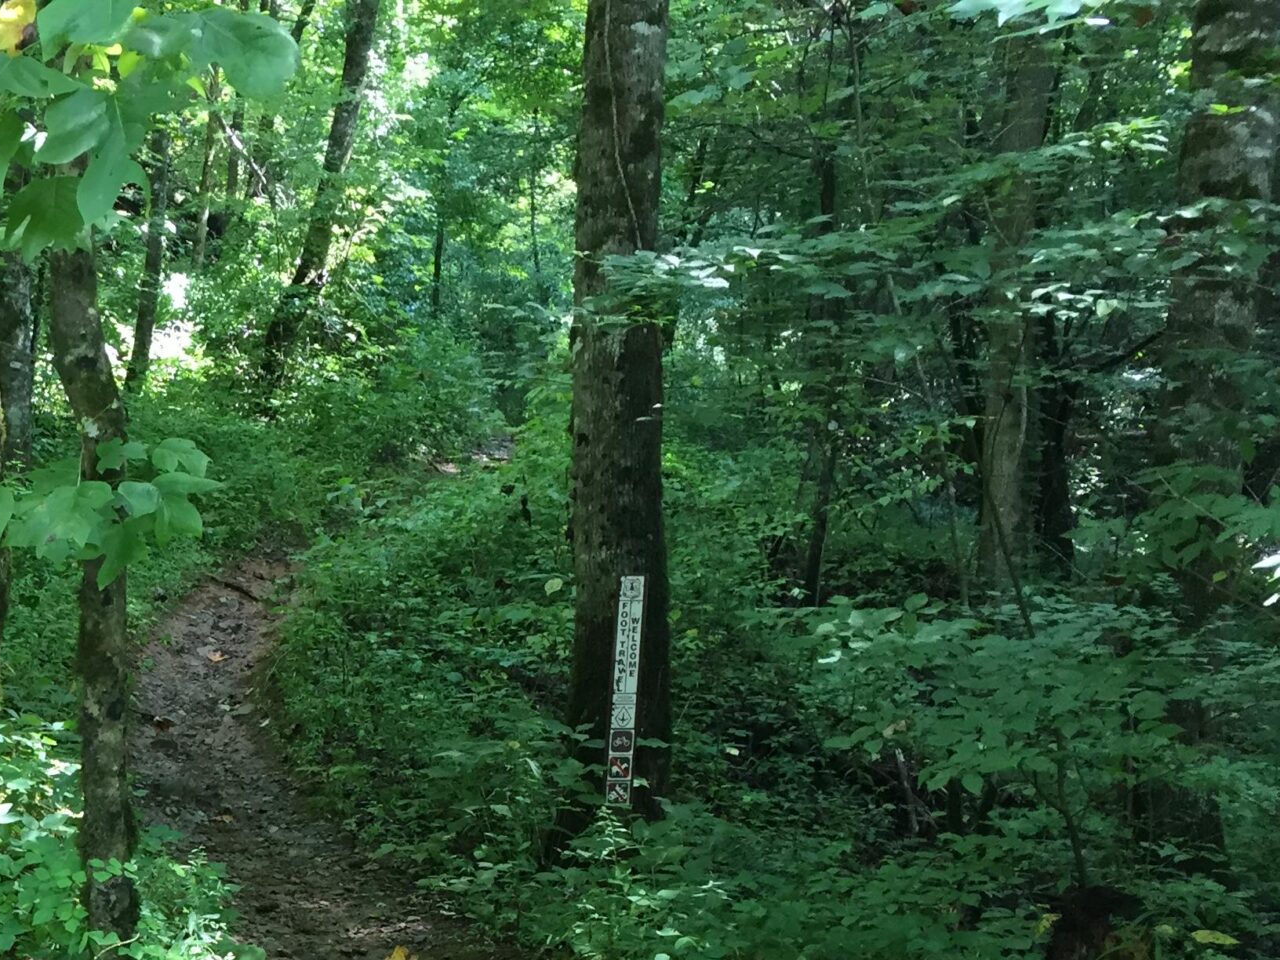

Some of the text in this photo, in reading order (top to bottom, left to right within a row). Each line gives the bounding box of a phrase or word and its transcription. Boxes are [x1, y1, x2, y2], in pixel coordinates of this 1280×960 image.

[620, 602, 629, 635] FOOT
[616, 640, 626, 692] TRAVEL
[628, 617, 640, 678] WELCOME
